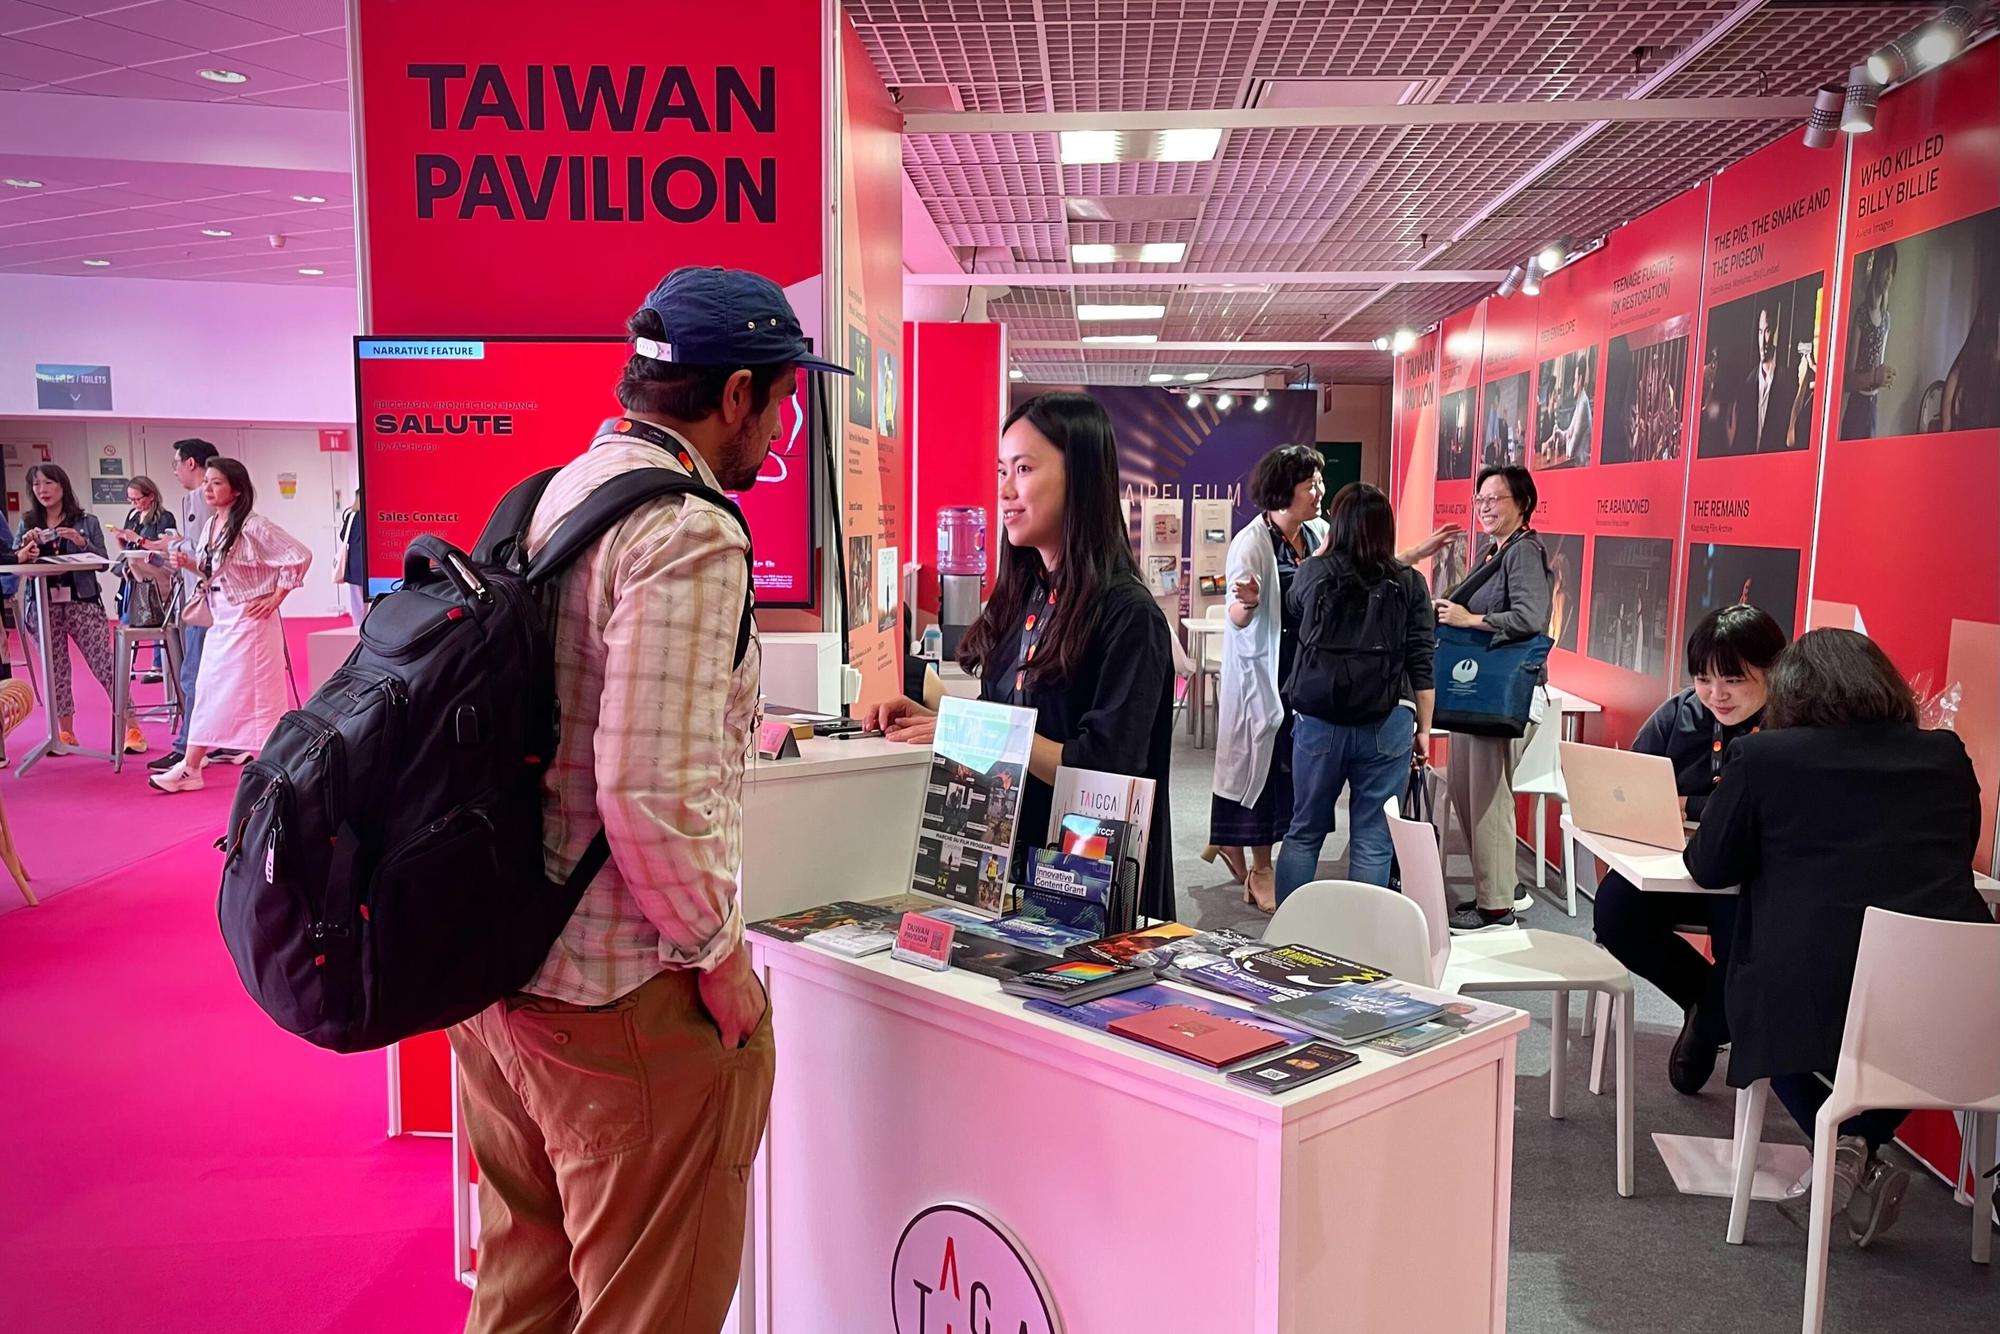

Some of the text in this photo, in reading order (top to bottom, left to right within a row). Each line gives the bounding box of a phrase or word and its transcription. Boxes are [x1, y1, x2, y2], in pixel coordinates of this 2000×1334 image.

[407, 63, 776, 133] TAIWAN
[1861, 134, 1944, 187] WHO KILLED
[415, 154, 777, 223] PAVILION
[1858, 168, 1940, 218] BILLY BILLIE
[1714, 187, 1831, 254] THE PIG, THE SNAKE AND
[1712, 243, 1764, 279] THE PIGEON
[1613, 270, 1642, 294] TEENAGE
[1642, 256, 1675, 284] FUGITIVE
[1621, 277, 1671, 313] RESTORATION)
[373, 346, 474, 356] NARRATIVE FEATURE
[1406, 348, 1436, 381] TAIWAN
[81, 375, 107, 385] TOILETS
[375, 414, 513, 435] SALUTE
[378, 511, 460, 522] Sales Contact
[1597, 499, 1650, 514] THE ABANDONED
[1693, 499, 1751, 518] THE REMAINS
[1036, 868, 1073, 881] Innovative
[1035, 877, 1085, 896] Content Grant
[904, 932, 928, 944] PAVILION
[907, 923, 930, 935] TAIWAN
